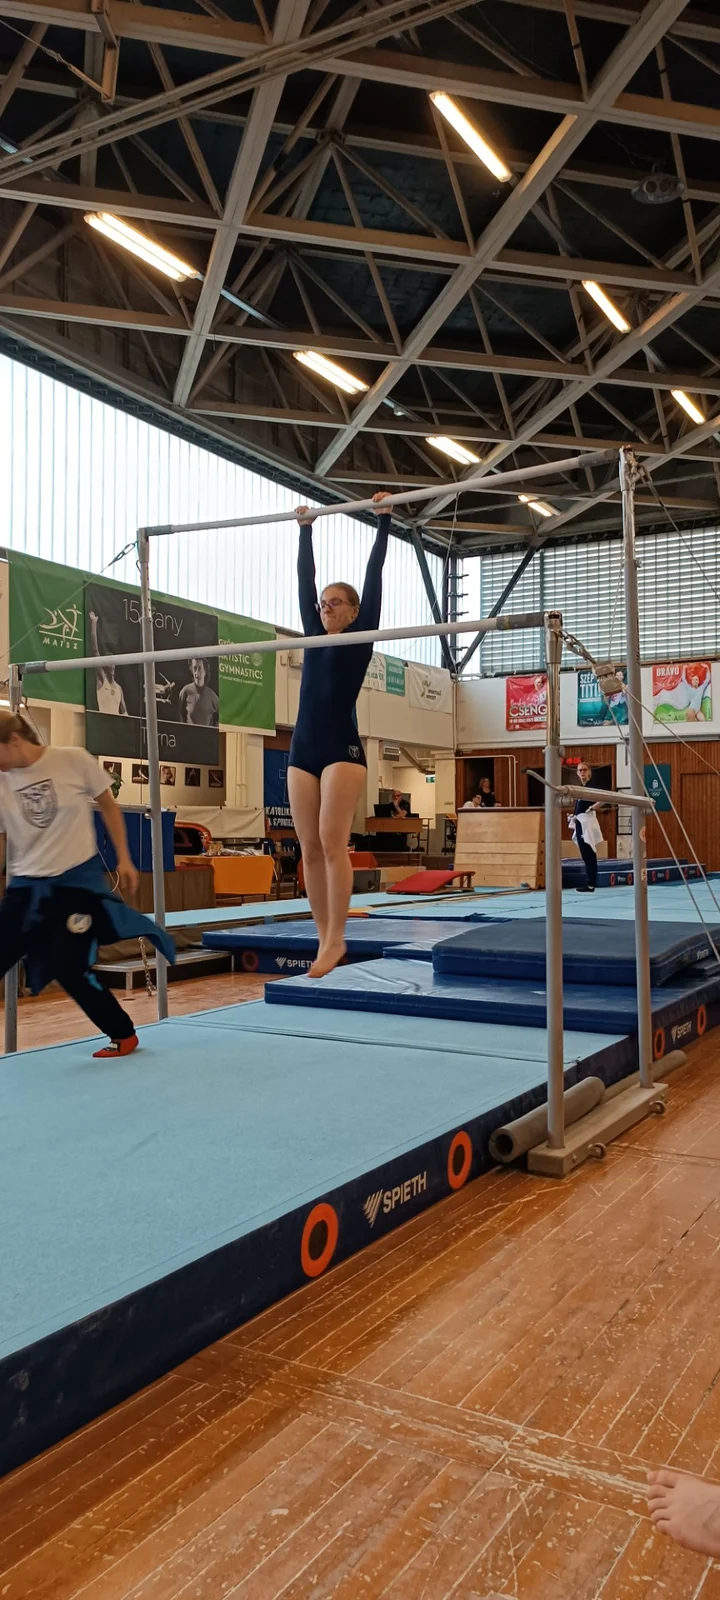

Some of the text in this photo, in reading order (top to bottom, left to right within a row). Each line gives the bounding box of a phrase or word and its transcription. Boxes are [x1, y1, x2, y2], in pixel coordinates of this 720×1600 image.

[42, 636, 78, 650] MATSZ
[218, 662, 264, 680] GYMNASTICS
[676, 1020, 693, 1039] SPIETH
[382, 1170, 427, 1214] SPIETH
